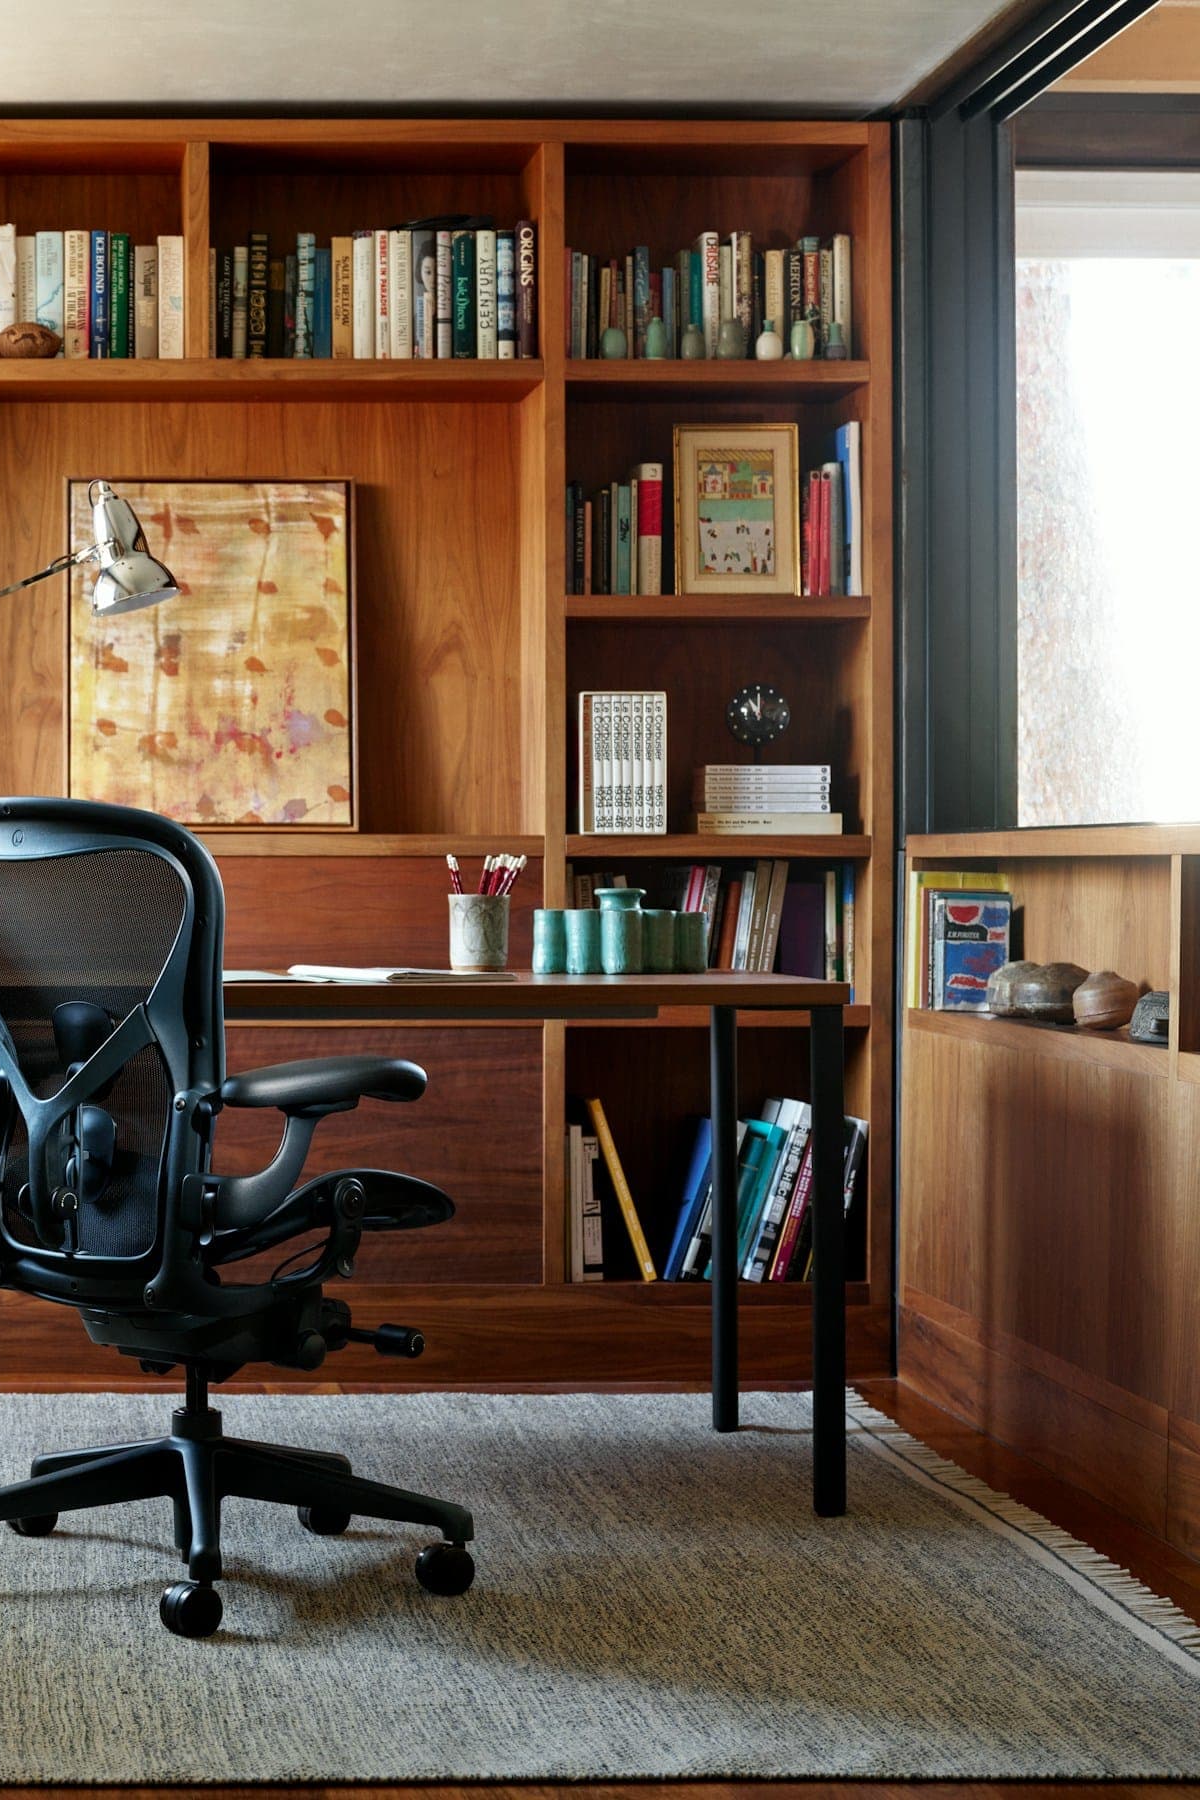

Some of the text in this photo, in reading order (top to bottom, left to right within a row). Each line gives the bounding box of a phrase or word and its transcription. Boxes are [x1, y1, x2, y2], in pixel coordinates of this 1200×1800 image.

[379, 235, 387, 265] REBELS
[379, 267, 387, 276] IN
[520, 227, 534, 287] ORIGINS
[706, 237, 719, 287] CRUSADE
[95, 256, 106, 294] BOUND
[223, 288, 231, 305] THE
[341, 256, 350, 327] SAUL BELLOW
[379, 279, 388, 317] PARADISE
[479, 257, 490, 329] CENTURY
[790, 254, 801, 306] MERTON
[594, 701, 601, 713] Le
[603, 701, 610, 713] Le
[613, 701, 621, 713] Le
[622, 701, 630, 713] Le
[594, 715, 602, 761] Corbusier
[603, 715, 611, 761] Corbusier
[613, 715, 622, 761] Corbusier
[622, 715, 631, 761] Corbusier
[634, 701, 643, 828] Le Corbusier 1952-57
[645, 701, 654, 828] Le Corbusier 1957-65
[655, 700, 664, 828] Le Corbusier 1965-69
